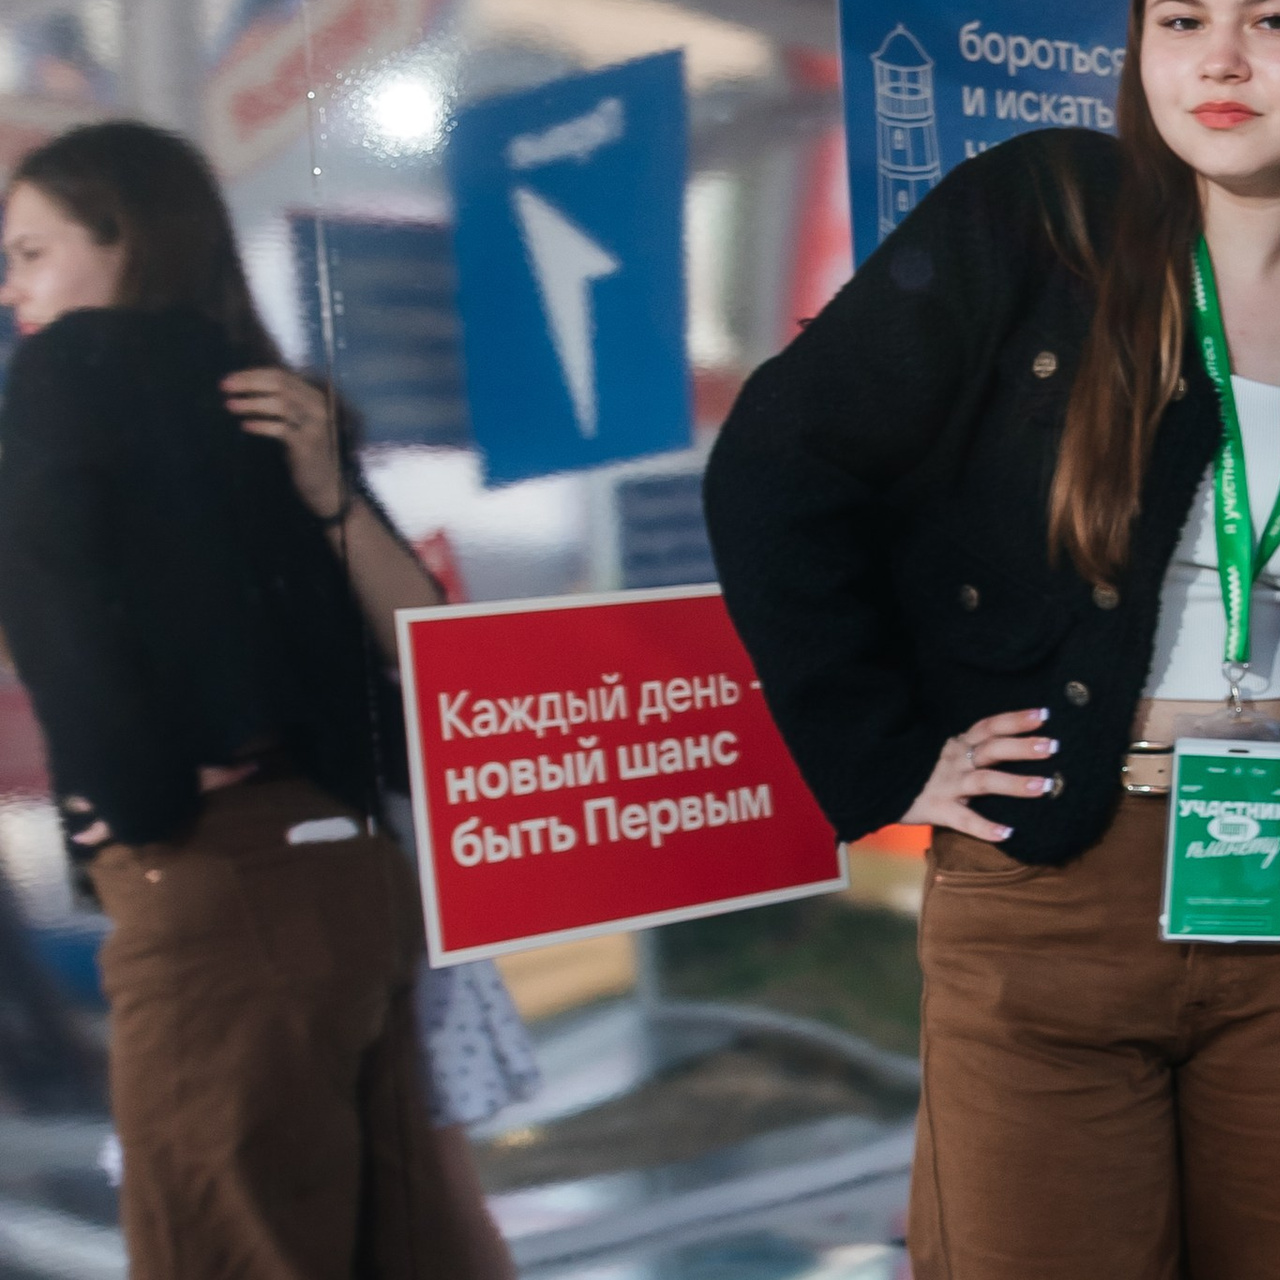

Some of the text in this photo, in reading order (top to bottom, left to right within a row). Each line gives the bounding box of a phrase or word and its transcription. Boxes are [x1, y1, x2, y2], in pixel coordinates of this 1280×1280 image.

[959, 20, 1127, 77] бороться
[962, 86, 1116, 129] и искать
[438, 672, 629, 741] Каждый
[638, 672, 740, 725] день
[444, 730, 740, 804] новый шанс
[451, 784, 772, 868] быть Первым
